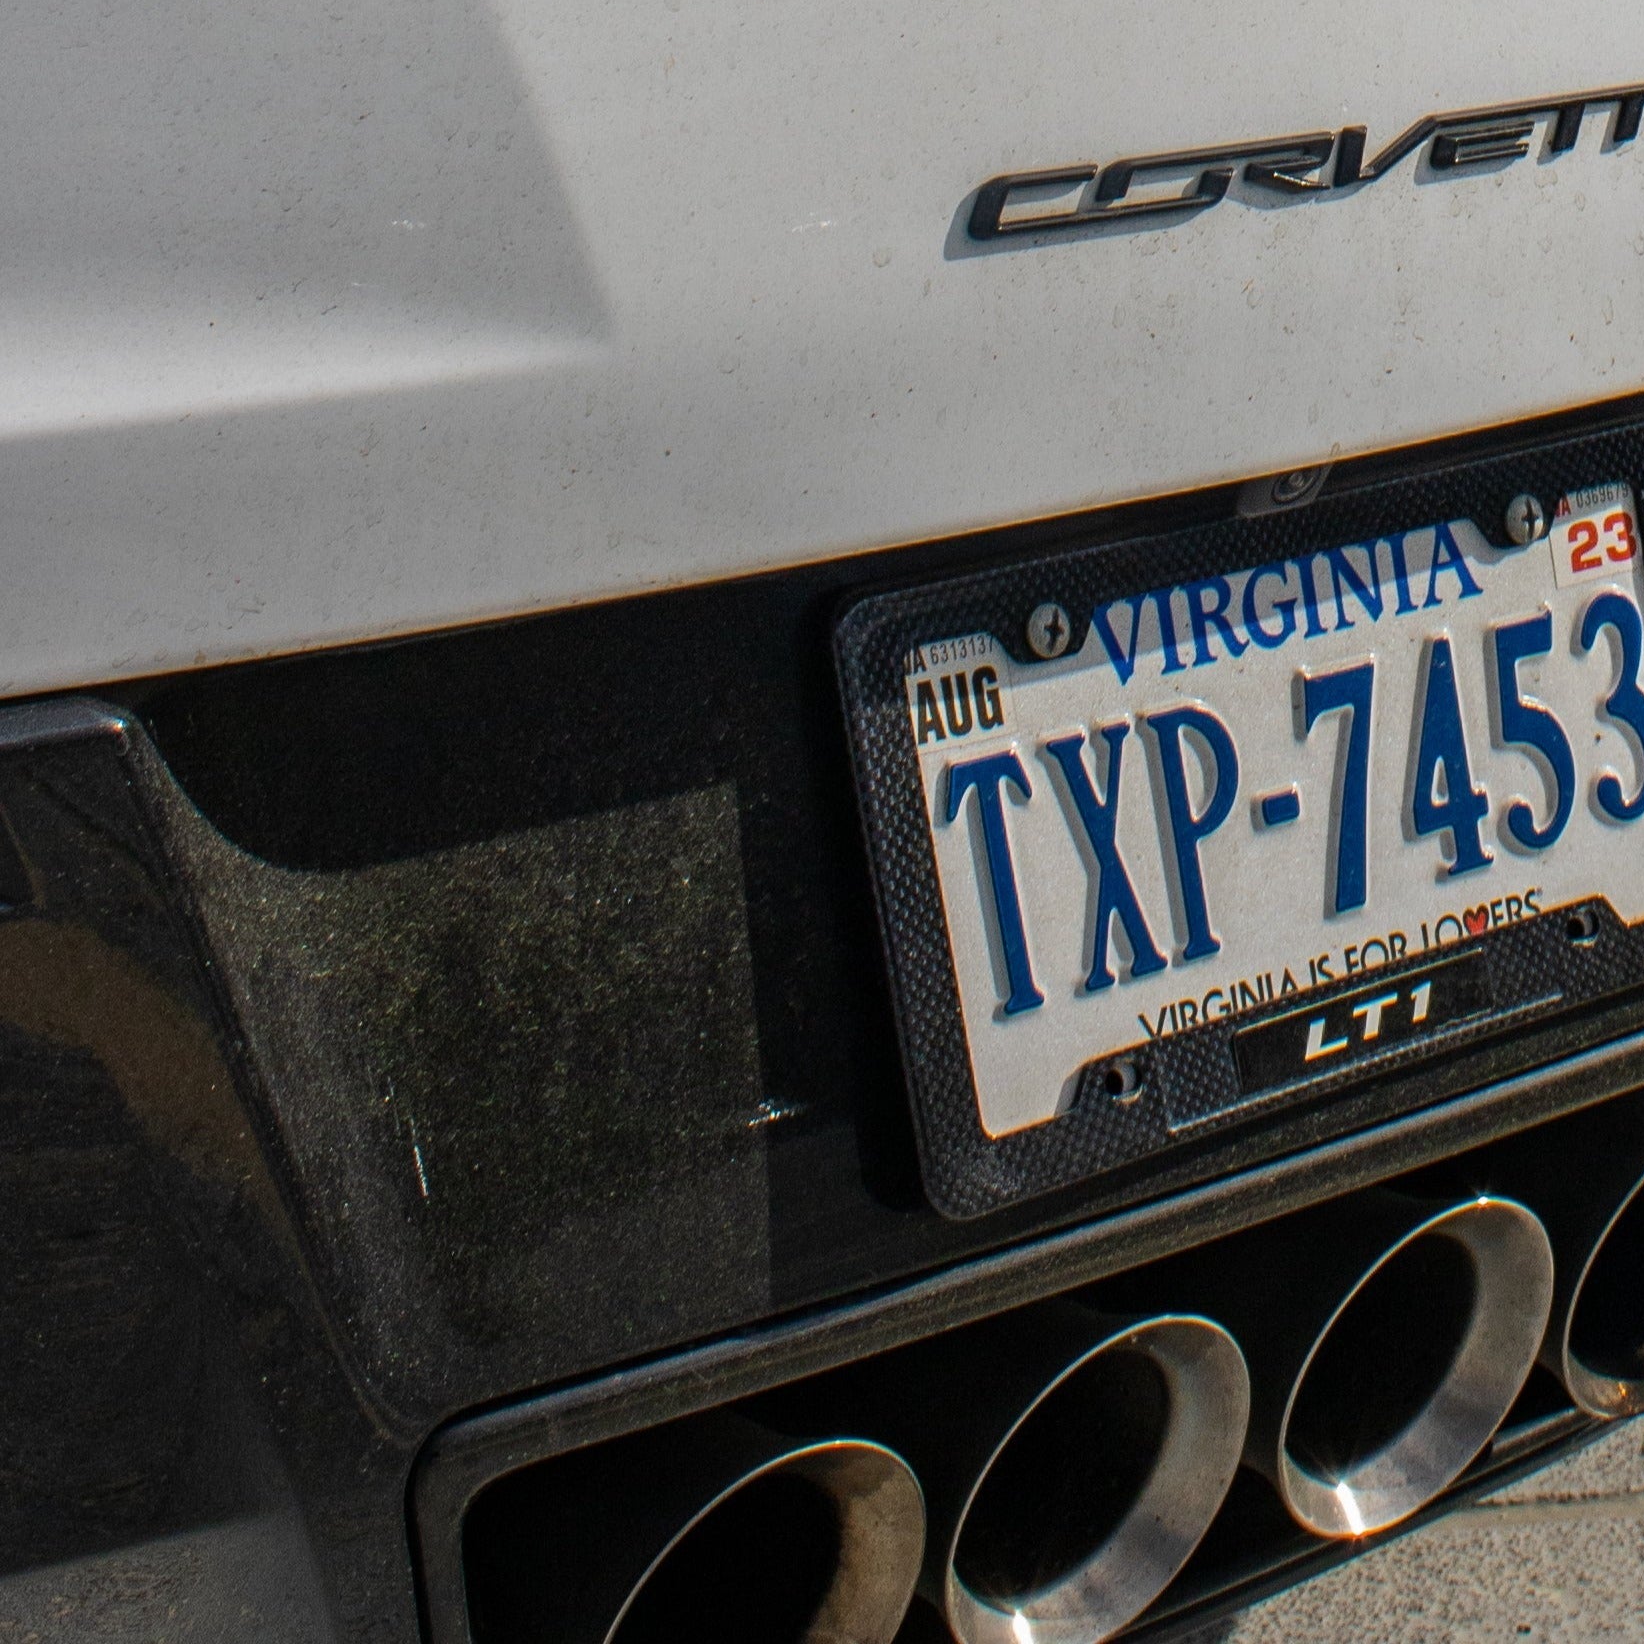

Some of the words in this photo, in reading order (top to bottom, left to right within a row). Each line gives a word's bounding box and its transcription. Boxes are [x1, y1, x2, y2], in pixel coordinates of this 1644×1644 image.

[1567, 510, 1637, 574] 23
[1090, 522, 1484, 687] VIRGINIA
[916, 664, 1005, 745] AUG
[1137, 965, 1298, 1037] VIRGINIA
[1308, 953, 1335, 987] IS
[1343, 931, 1408, 974] FOR
[1304, 980, 1433, 1062] LT1
